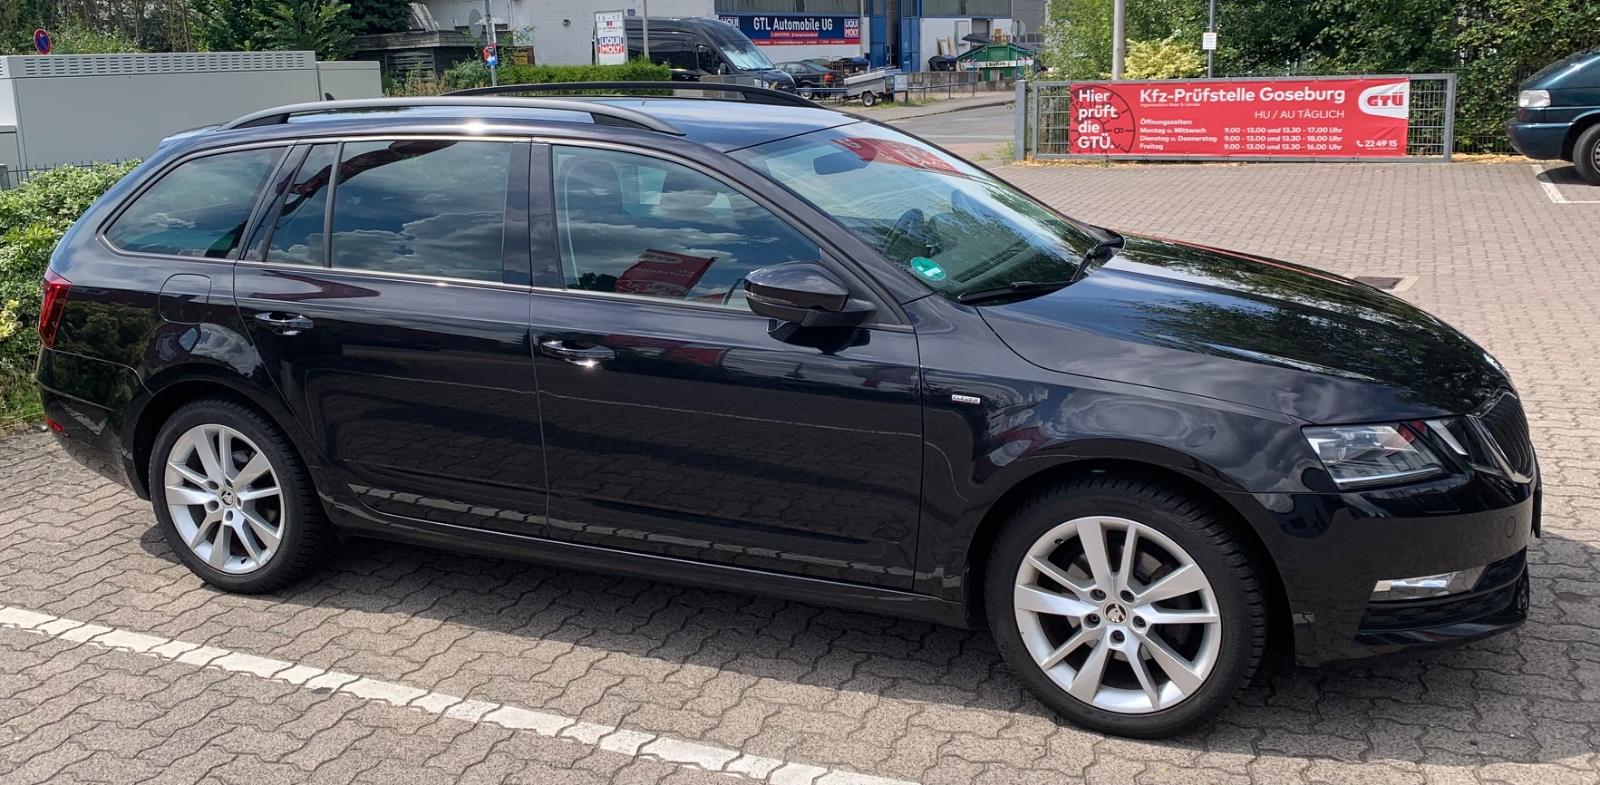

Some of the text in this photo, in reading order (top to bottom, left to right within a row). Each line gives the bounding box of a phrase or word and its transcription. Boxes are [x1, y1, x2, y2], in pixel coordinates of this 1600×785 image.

[753, 17, 833, 30] GTL Automobile UG
[845, 19, 859, 28] LIQUI
[845, 28, 859, 37] MOLY
[601, 37, 621, 45] LIQUI
[601, 45, 621, 53] MOLY
[1078, 89, 1111, 103] Hier
[1139, 85, 1346, 104] Kfz-Prüfstelle Goseburg
[1366, 91, 1404, 107] GTÜ
[1078, 104, 1118, 120] prüft
[1254, 110, 1270, 119] HU
[1280, 110, 1296, 119] AU
[1298, 108, 1345, 119] TÄGLICH
[1078, 120, 1100, 133] die
[1139, 118, 1193, 126] Öffnungszeiten:
[1139, 127, 1165, 135] Montag
[1078, 132, 1114, 149] GTÜ.
[1139, 135, 1169, 143] Dienstag
[1178, 135, 1218, 143] Donnerstag
[1139, 143, 1163, 151] Freitag
